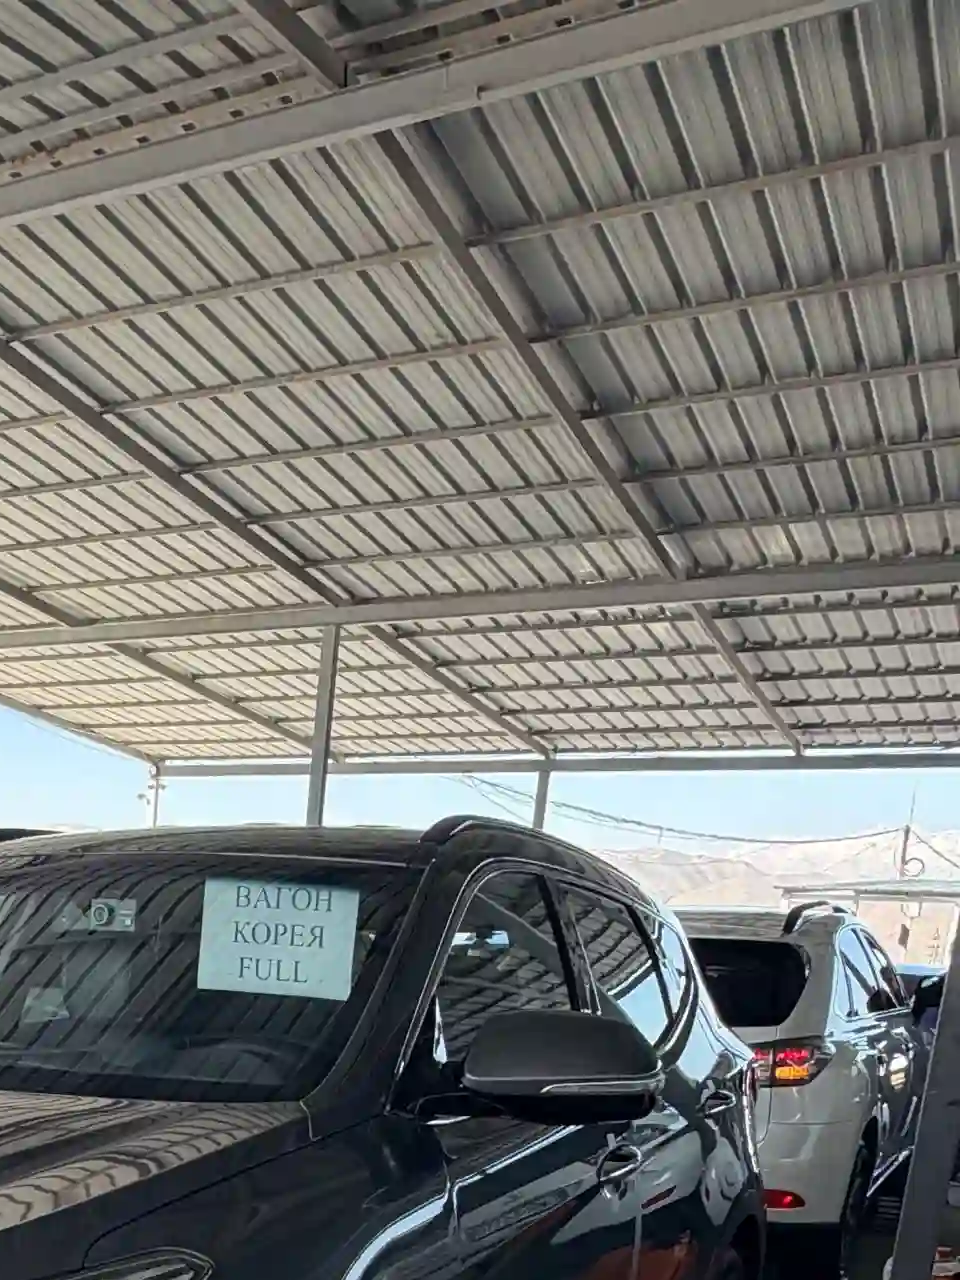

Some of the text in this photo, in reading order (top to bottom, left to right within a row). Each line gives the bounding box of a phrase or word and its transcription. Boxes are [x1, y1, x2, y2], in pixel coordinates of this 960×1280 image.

[235, 885, 333, 913] ВАГОН
[231, 920, 326, 949] КОРЕЯ
[238, 956, 309, 984] FULL
